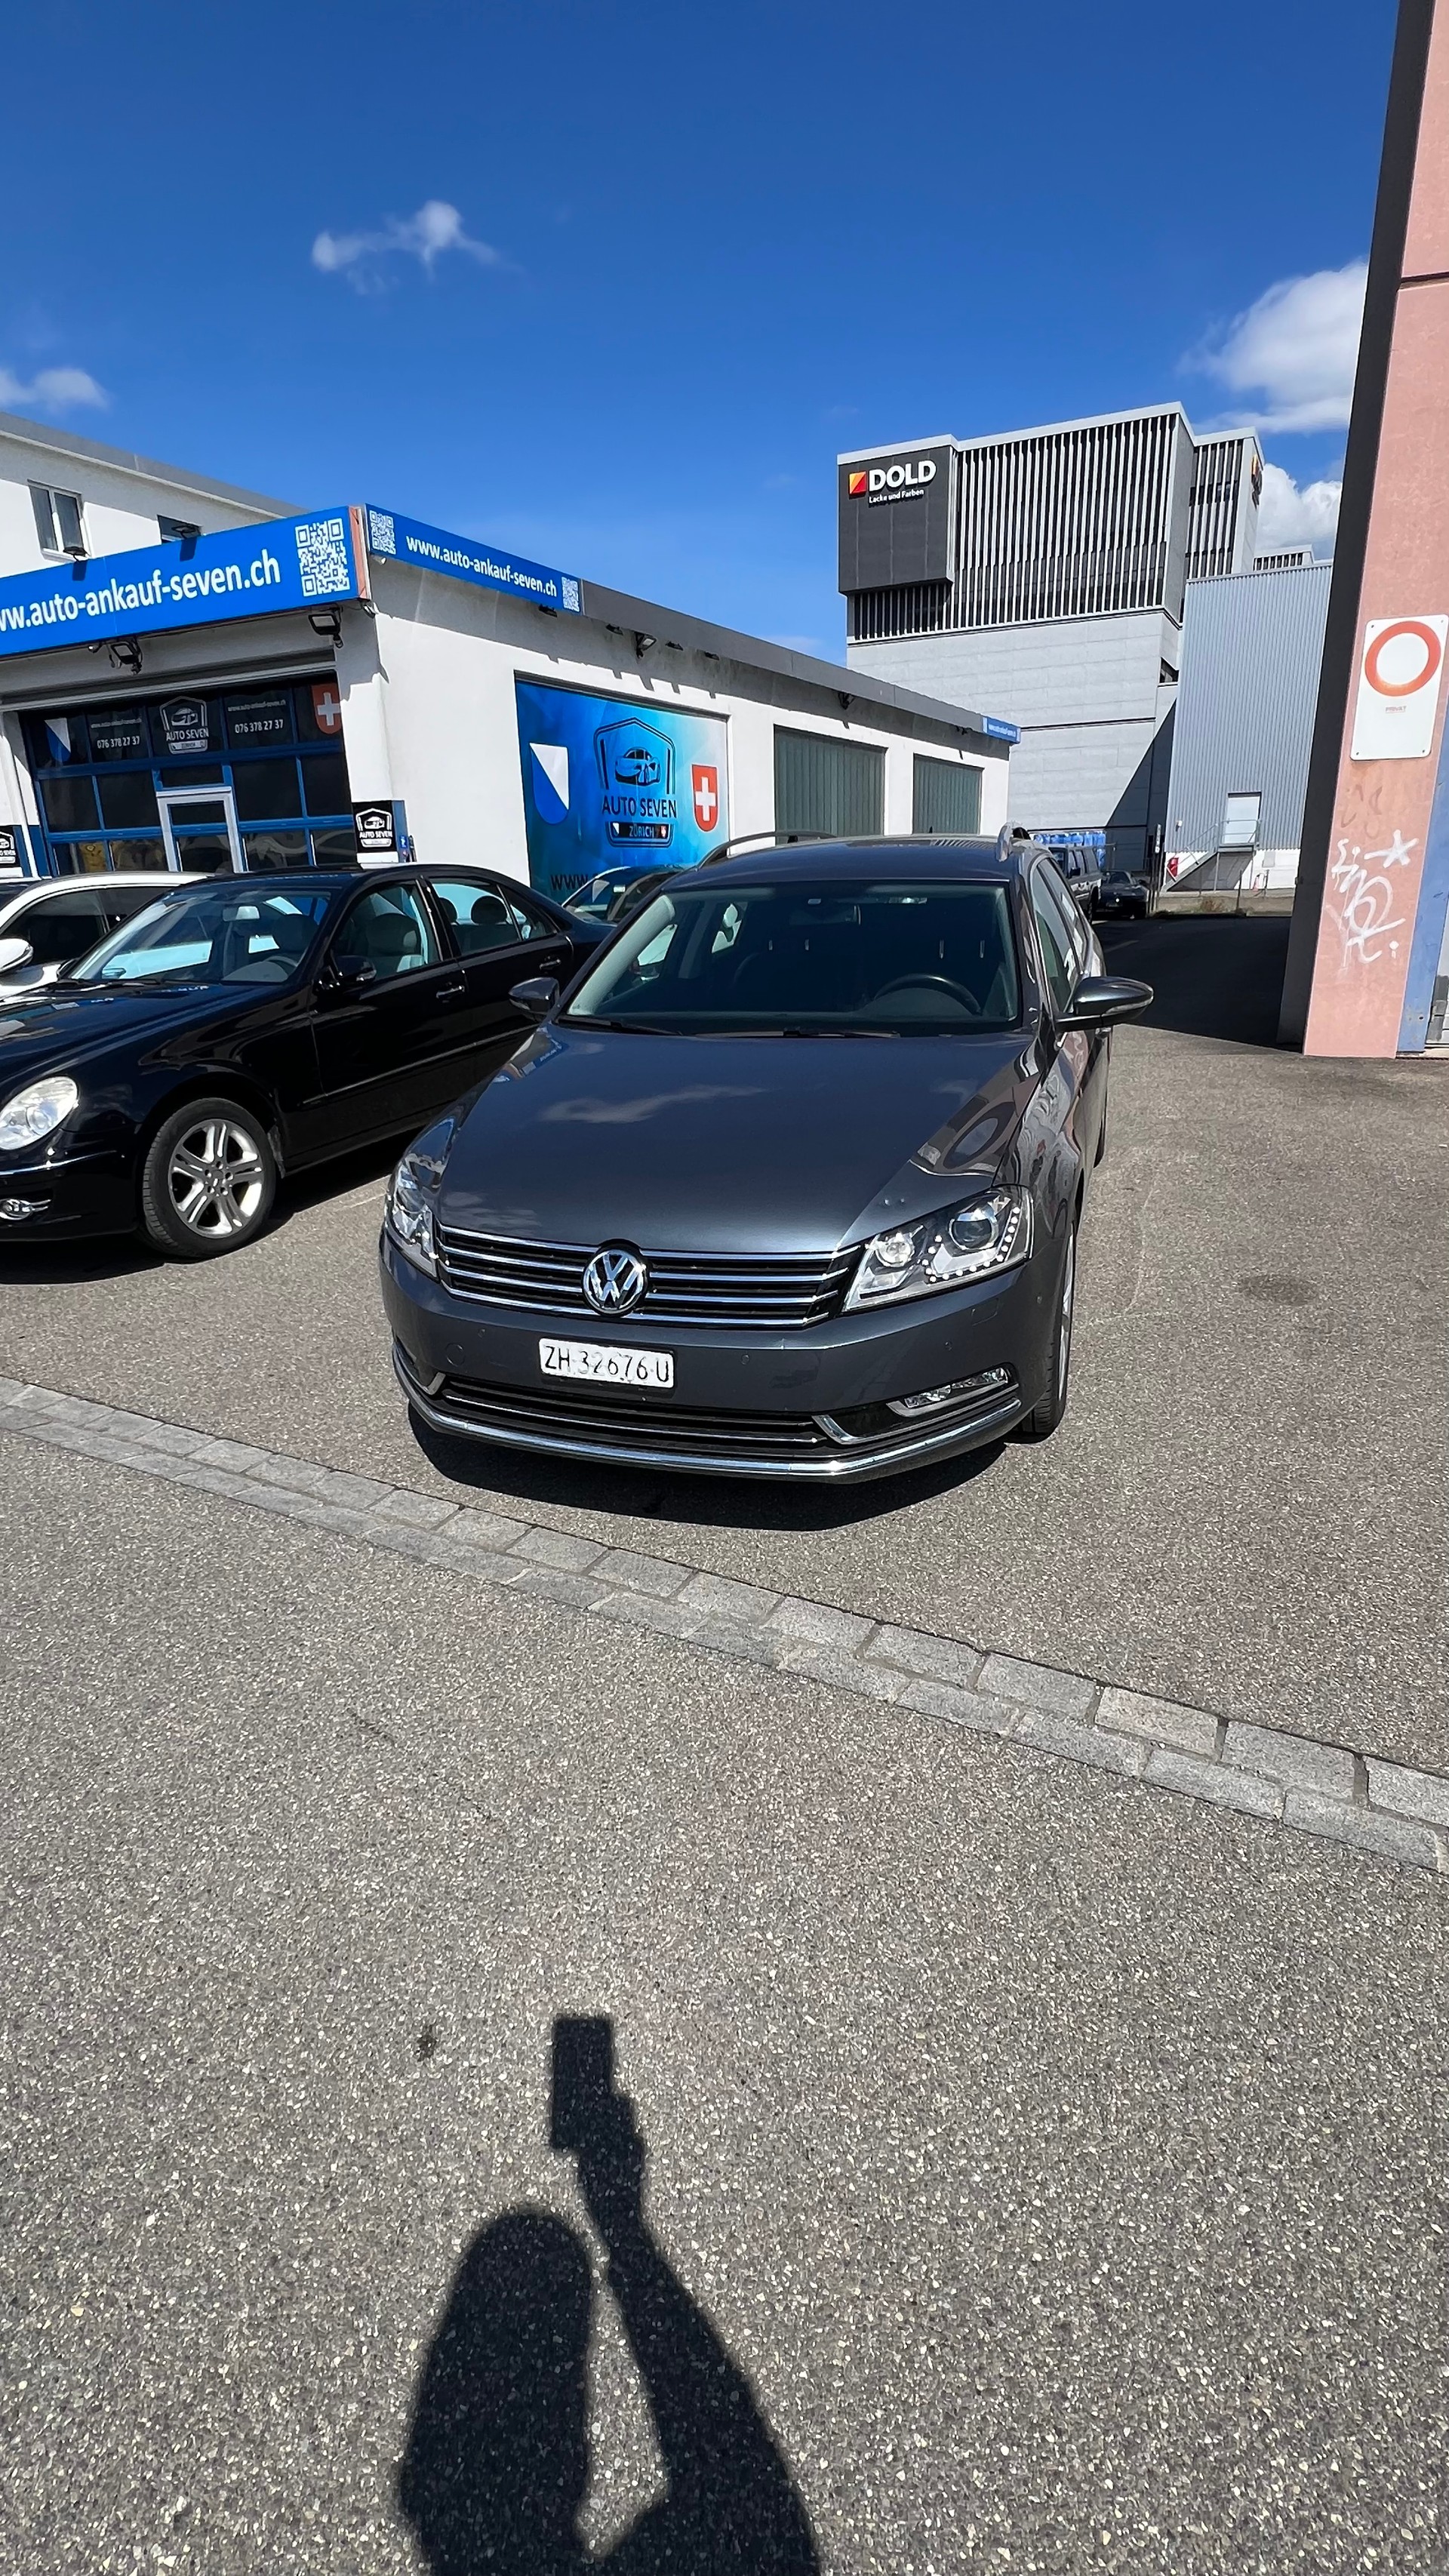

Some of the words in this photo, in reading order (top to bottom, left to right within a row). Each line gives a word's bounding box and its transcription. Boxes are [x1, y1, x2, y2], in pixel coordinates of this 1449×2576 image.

[869, 460, 937, 491] DOLD
[869, 494, 888, 503] Lacke
[888, 491, 901, 500] und
[901, 488, 924, 498] Farben
[405, 535, 557, 597] www.auto-ankauf-seven.ch
[235, 724, 249, 734] 076
[250, 722, 263, 732] 378
[263, 720, 272, 730] 27
[274, 719, 284, 729] 37
[131, 735, 140, 745] 37
[166, 730, 186, 741] AUTO
[186, 728, 209, 739] SEVEN
[601, 795, 637, 817] AUTO
[639, 797, 677, 818] SEVEN
[629, 823, 654, 838] ZÜRICH
